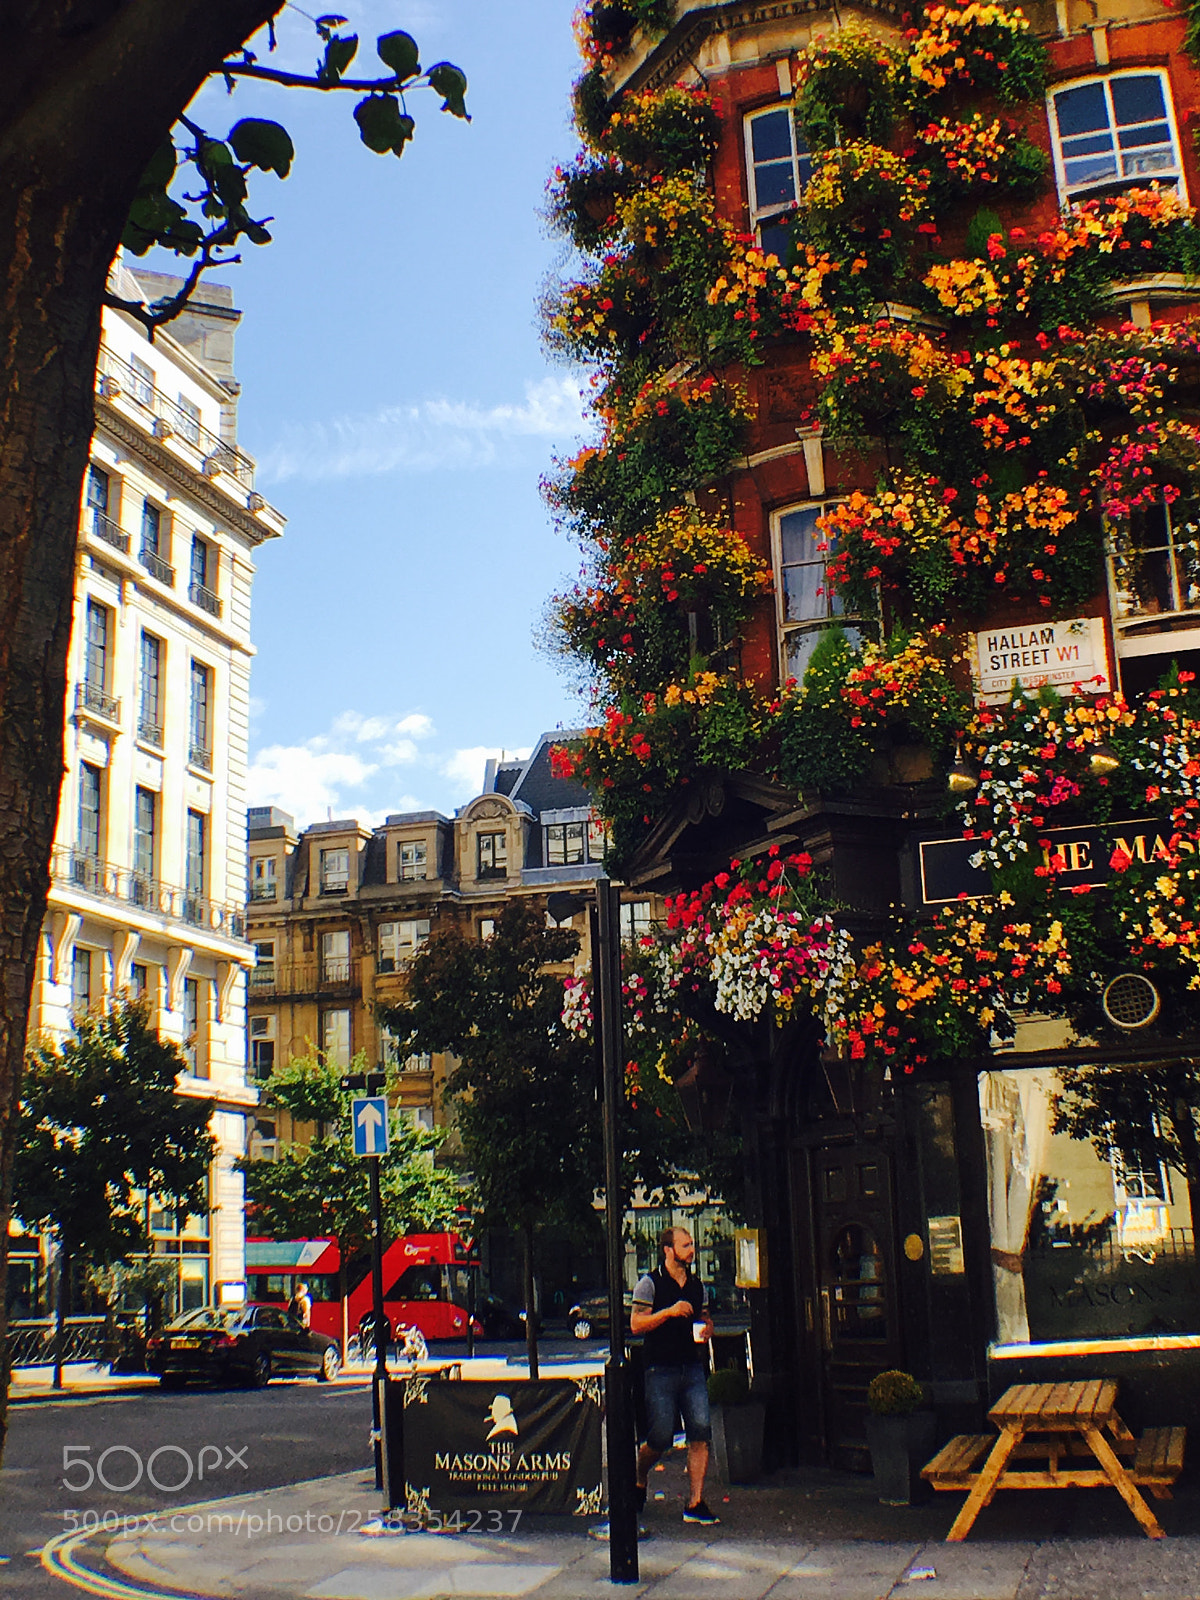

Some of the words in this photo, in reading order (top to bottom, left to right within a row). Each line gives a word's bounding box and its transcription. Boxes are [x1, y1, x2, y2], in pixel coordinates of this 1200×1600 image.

[987, 627, 1054, 652] HALLAM
[990, 648, 1050, 671] STREET
[1056, 645, 1079, 662] W1
[991, 679, 1007, 688] CITY
[488, 1441, 515, 1455] THE
[434, 1451, 511, 1472] MASONS
[515, 1451, 571, 1471] ARMS
